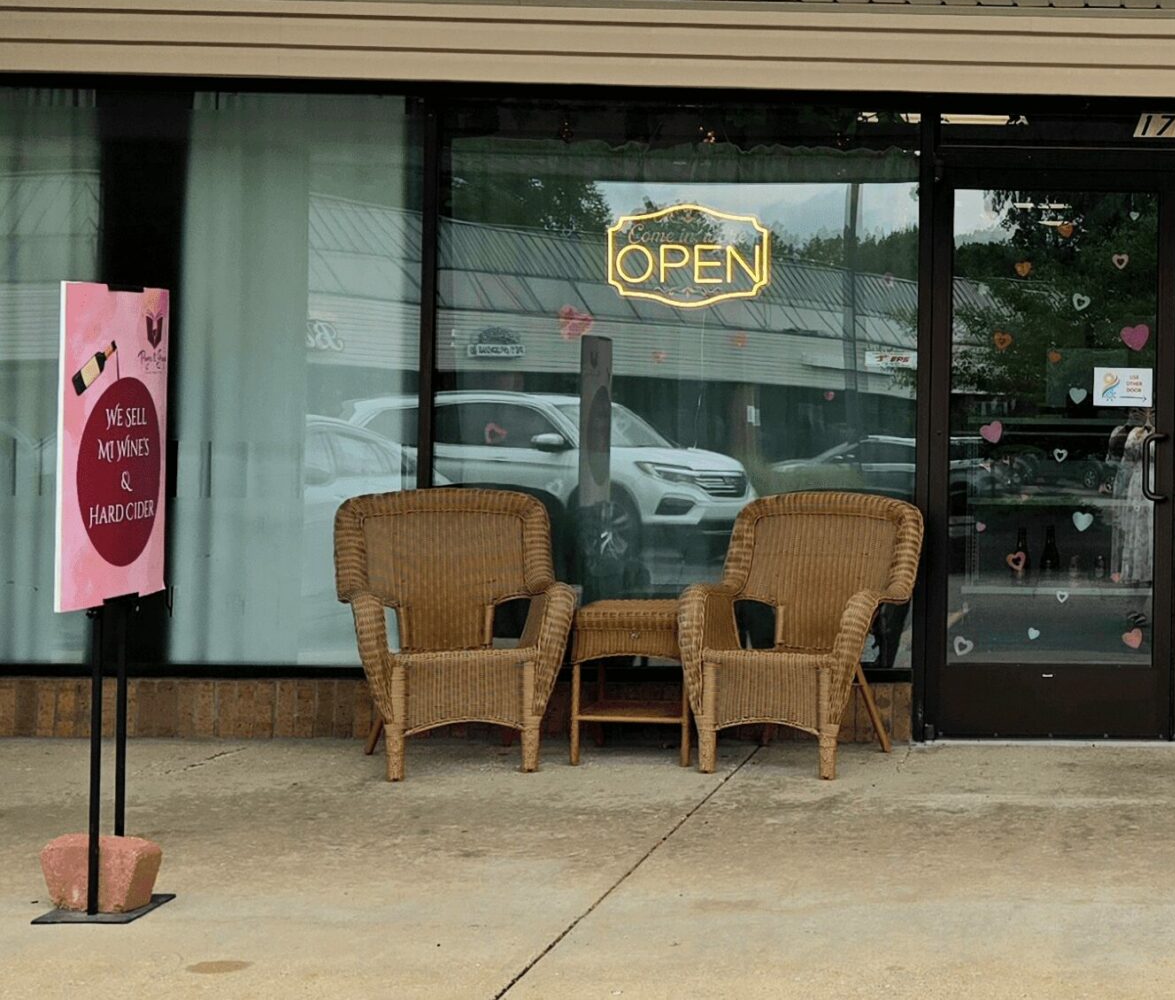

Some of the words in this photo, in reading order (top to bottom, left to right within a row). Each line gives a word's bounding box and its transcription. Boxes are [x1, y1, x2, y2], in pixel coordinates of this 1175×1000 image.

[627, 223, 675, 244] Come
[616, 244, 760, 283] OPEN
[105, 403, 123, 430] WE
[125, 407, 147, 428] SELL
[121, 471, 133, 492] &
[89, 503, 124, 529] HARD
[125, 499, 154, 521] CIDER
